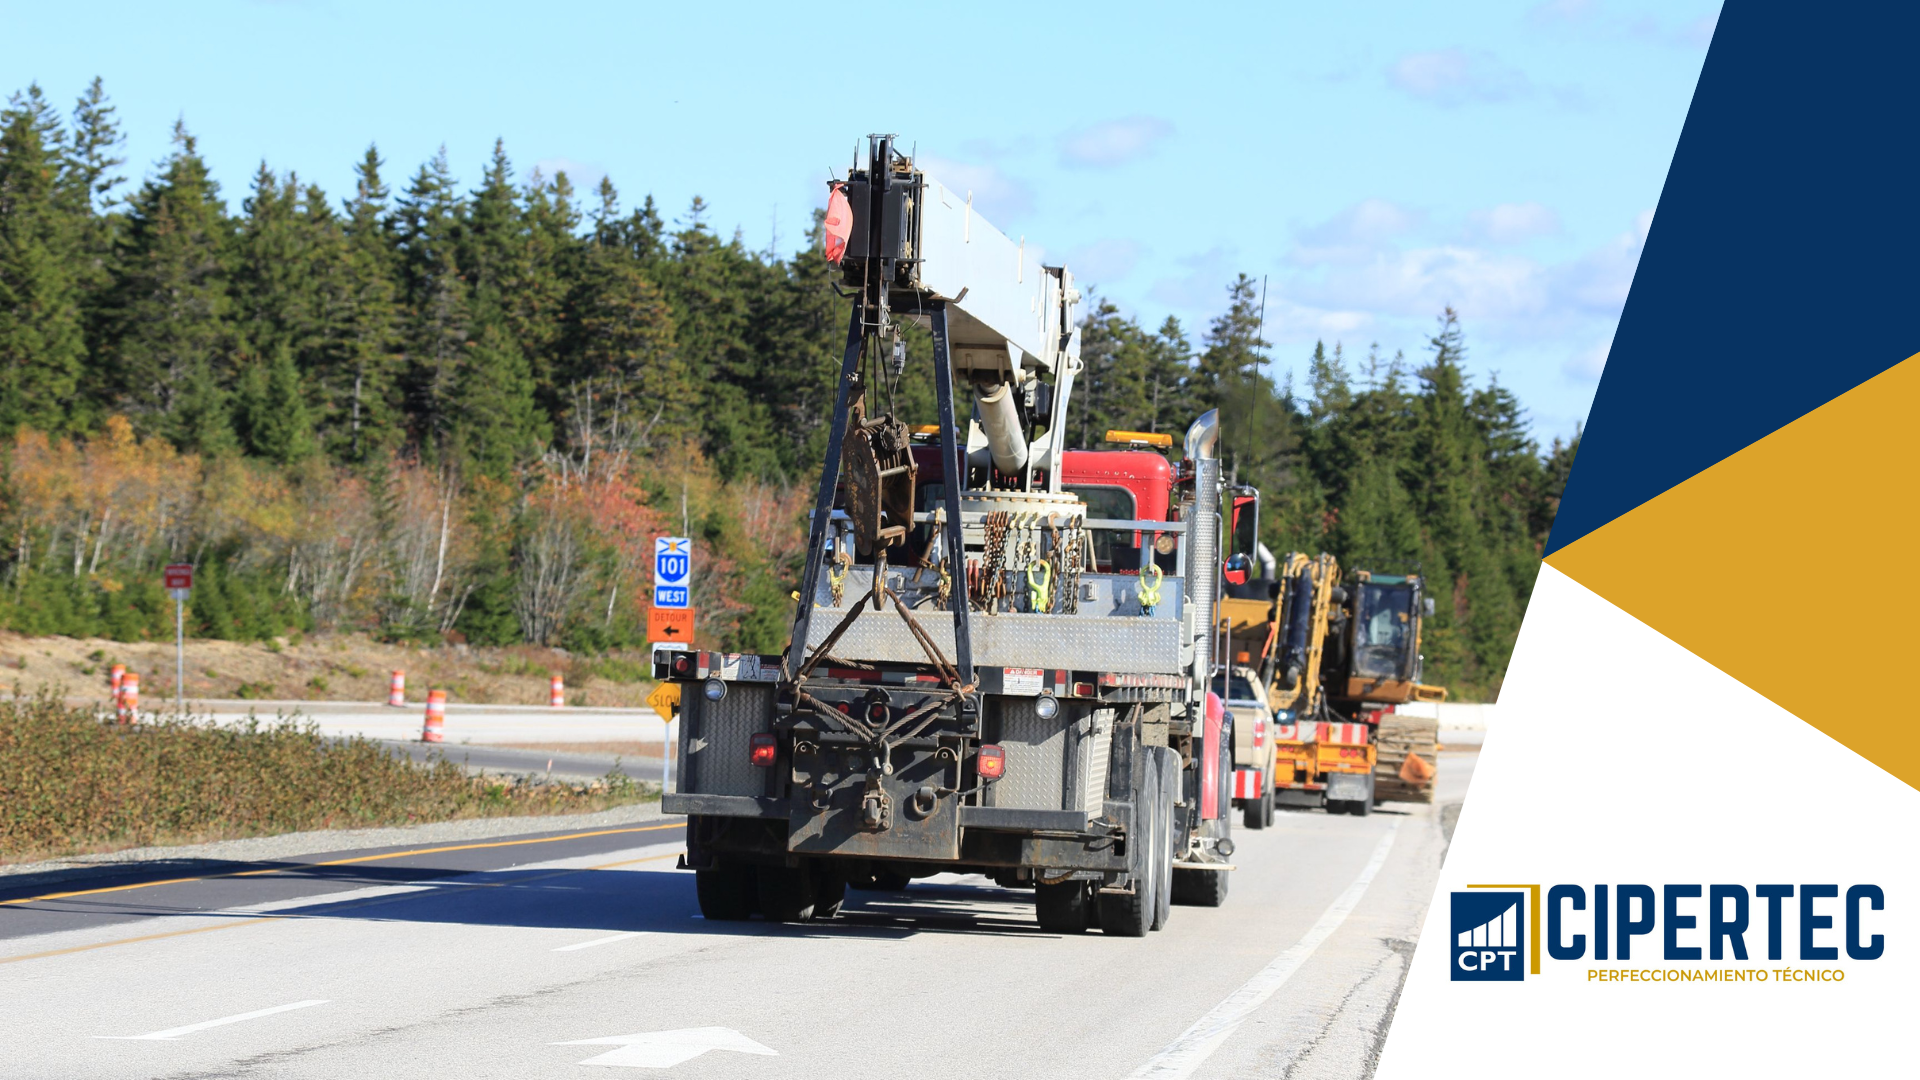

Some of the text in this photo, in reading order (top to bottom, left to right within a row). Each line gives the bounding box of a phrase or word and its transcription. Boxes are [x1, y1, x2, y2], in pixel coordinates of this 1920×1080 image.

[661, 558, 685, 575] 101
[658, 590, 686, 603] WEST
[655, 613, 687, 622] DETOUR
